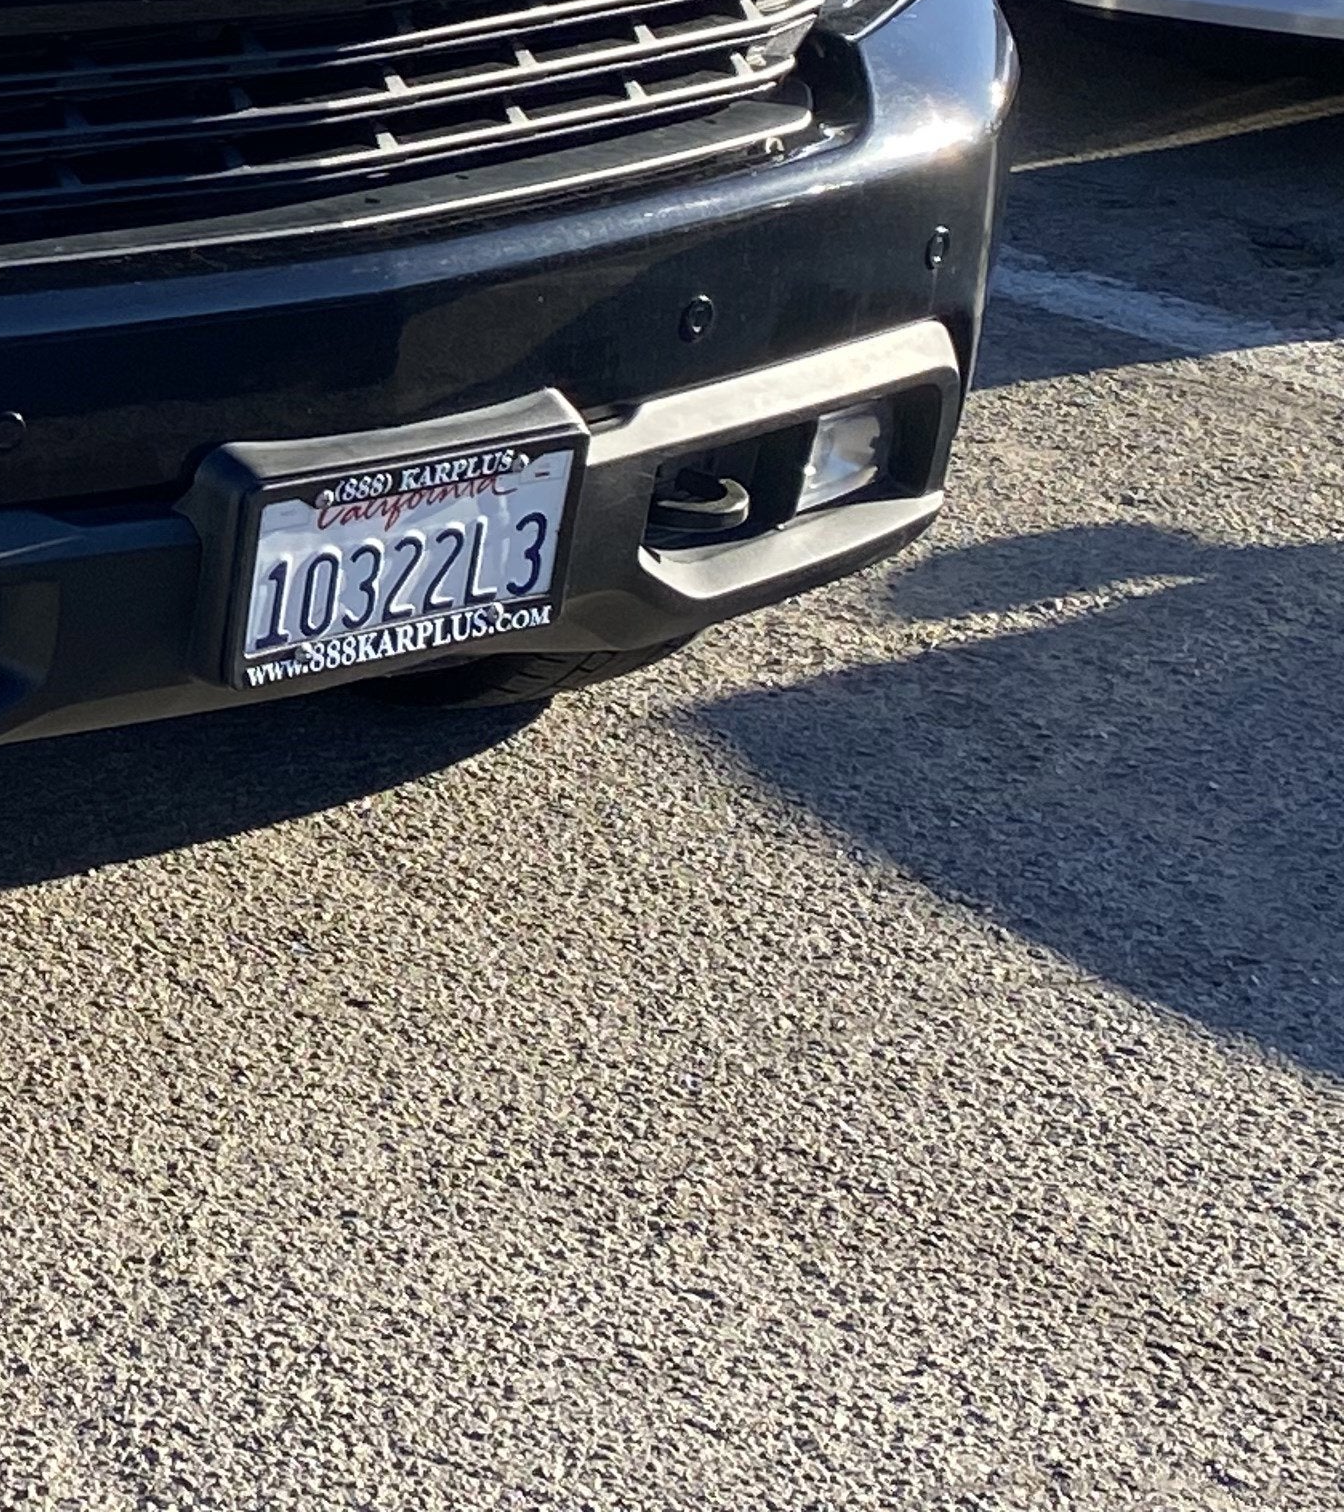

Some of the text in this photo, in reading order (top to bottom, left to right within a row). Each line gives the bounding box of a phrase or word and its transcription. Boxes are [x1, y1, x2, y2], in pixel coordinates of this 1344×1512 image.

[317, 475, 518, 532] California
[335, 449, 515, 502] (888) KARPLUS
[255, 511, 548, 650] 10322L3
